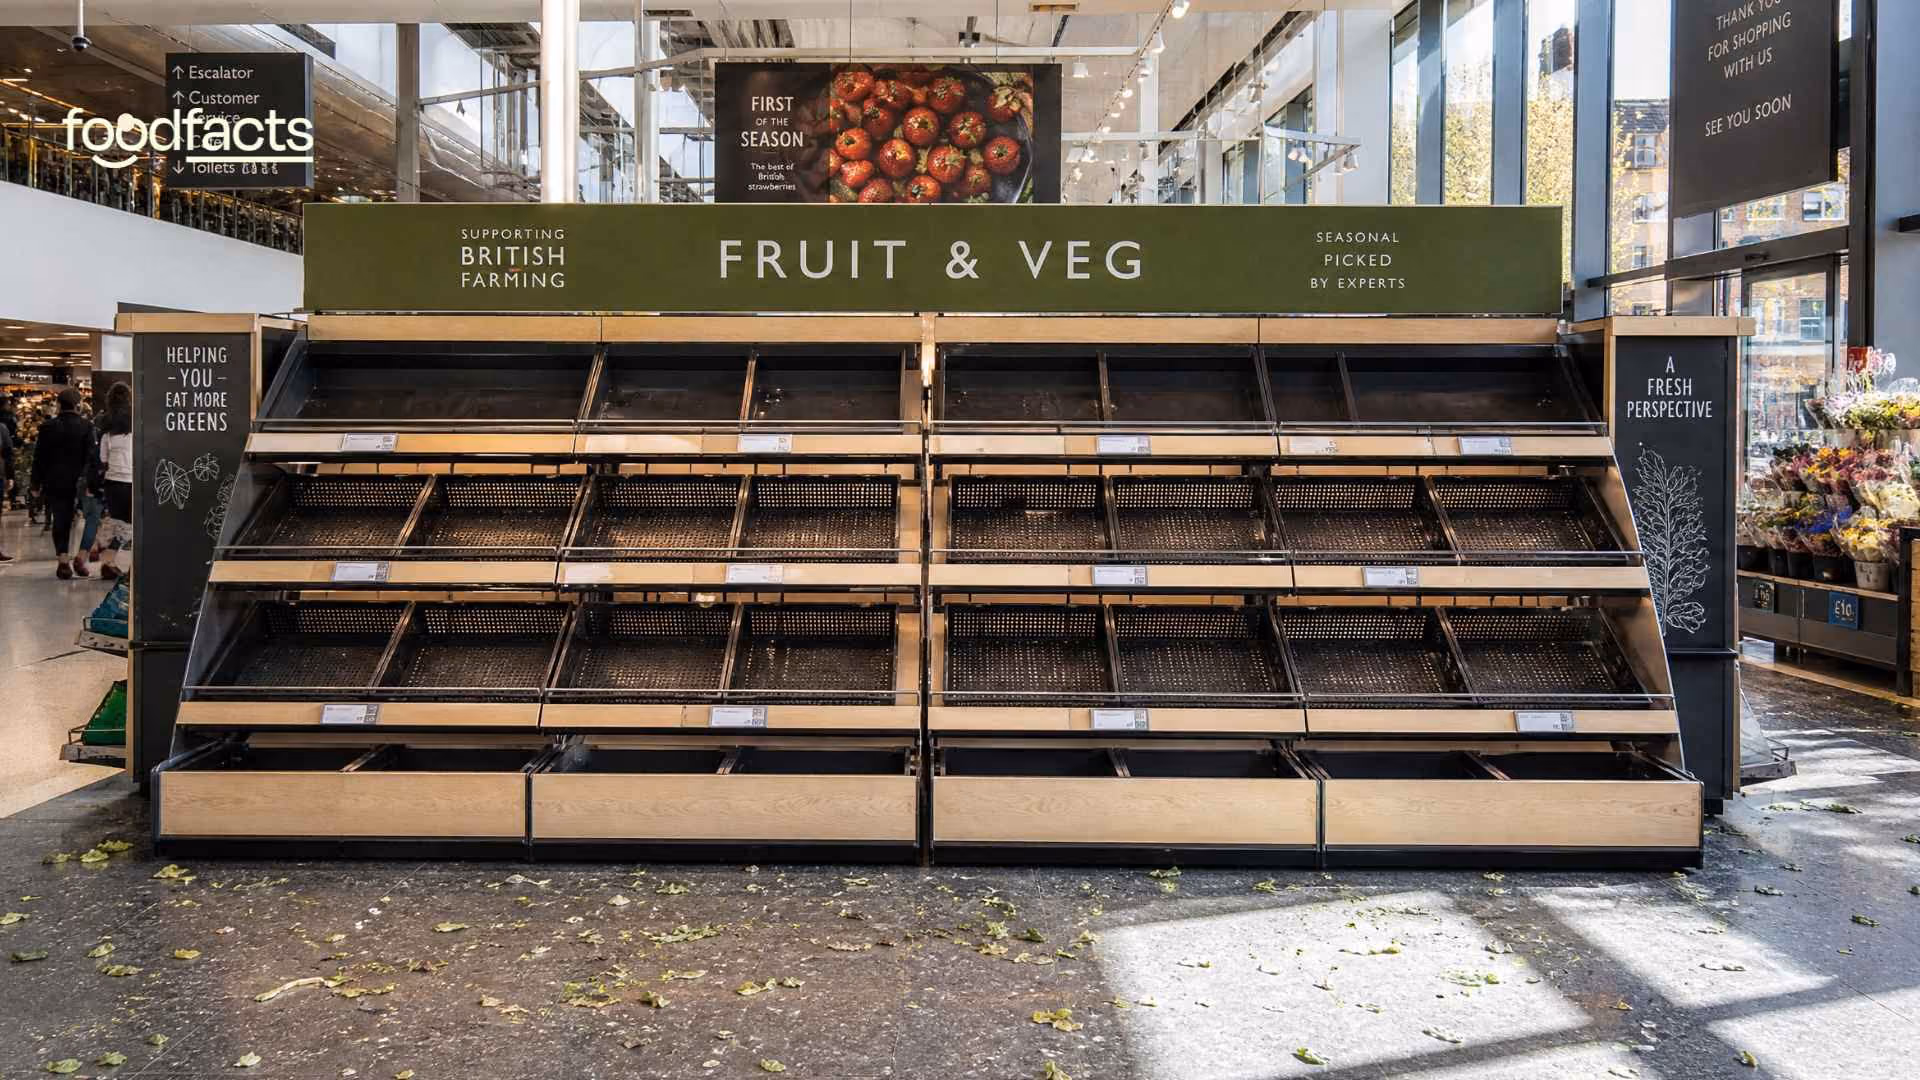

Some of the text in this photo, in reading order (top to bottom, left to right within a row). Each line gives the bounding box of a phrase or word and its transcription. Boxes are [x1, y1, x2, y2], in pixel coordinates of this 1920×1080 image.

[1715, 0, 1783, 31] THANK YO
[1708, 11, 1791, 62] FOR SHOPPING
[1723, 47, 1772, 79] WITH US
[189, 65, 254, 80] Escalator
[189, 91, 260, 105] Customer
[751, 96, 794, 112] FIRST
[755, 117, 789, 126] OF THE
[1705, 93, 1791, 137] SEE YOU SOON
[740, 131, 804, 147] SEASON
[751, 162, 766, 170] The
[785, 162, 794, 171] of
[461, 229, 565, 240] SUPPORTING
[1316, 232, 1400, 243] SEASONAL
[461, 246, 565, 266] BRITISH
[719, 239, 1142, 280] FRUIT & VEG
[1324, 254, 1392, 267] PICKED
[461, 272, 565, 288] FARMING
[1310, 278, 1406, 289] BY EXPERTS
[167, 346, 227, 363] HELPING
[1665, 356, 1675, 373] A
[1647, 377, 1692, 396] FRESH
[165, 391, 228, 408] EAT MORE
[1627, 400, 1713, 418] PERSPECTIVE
[165, 411, 228, 432] GREENS
